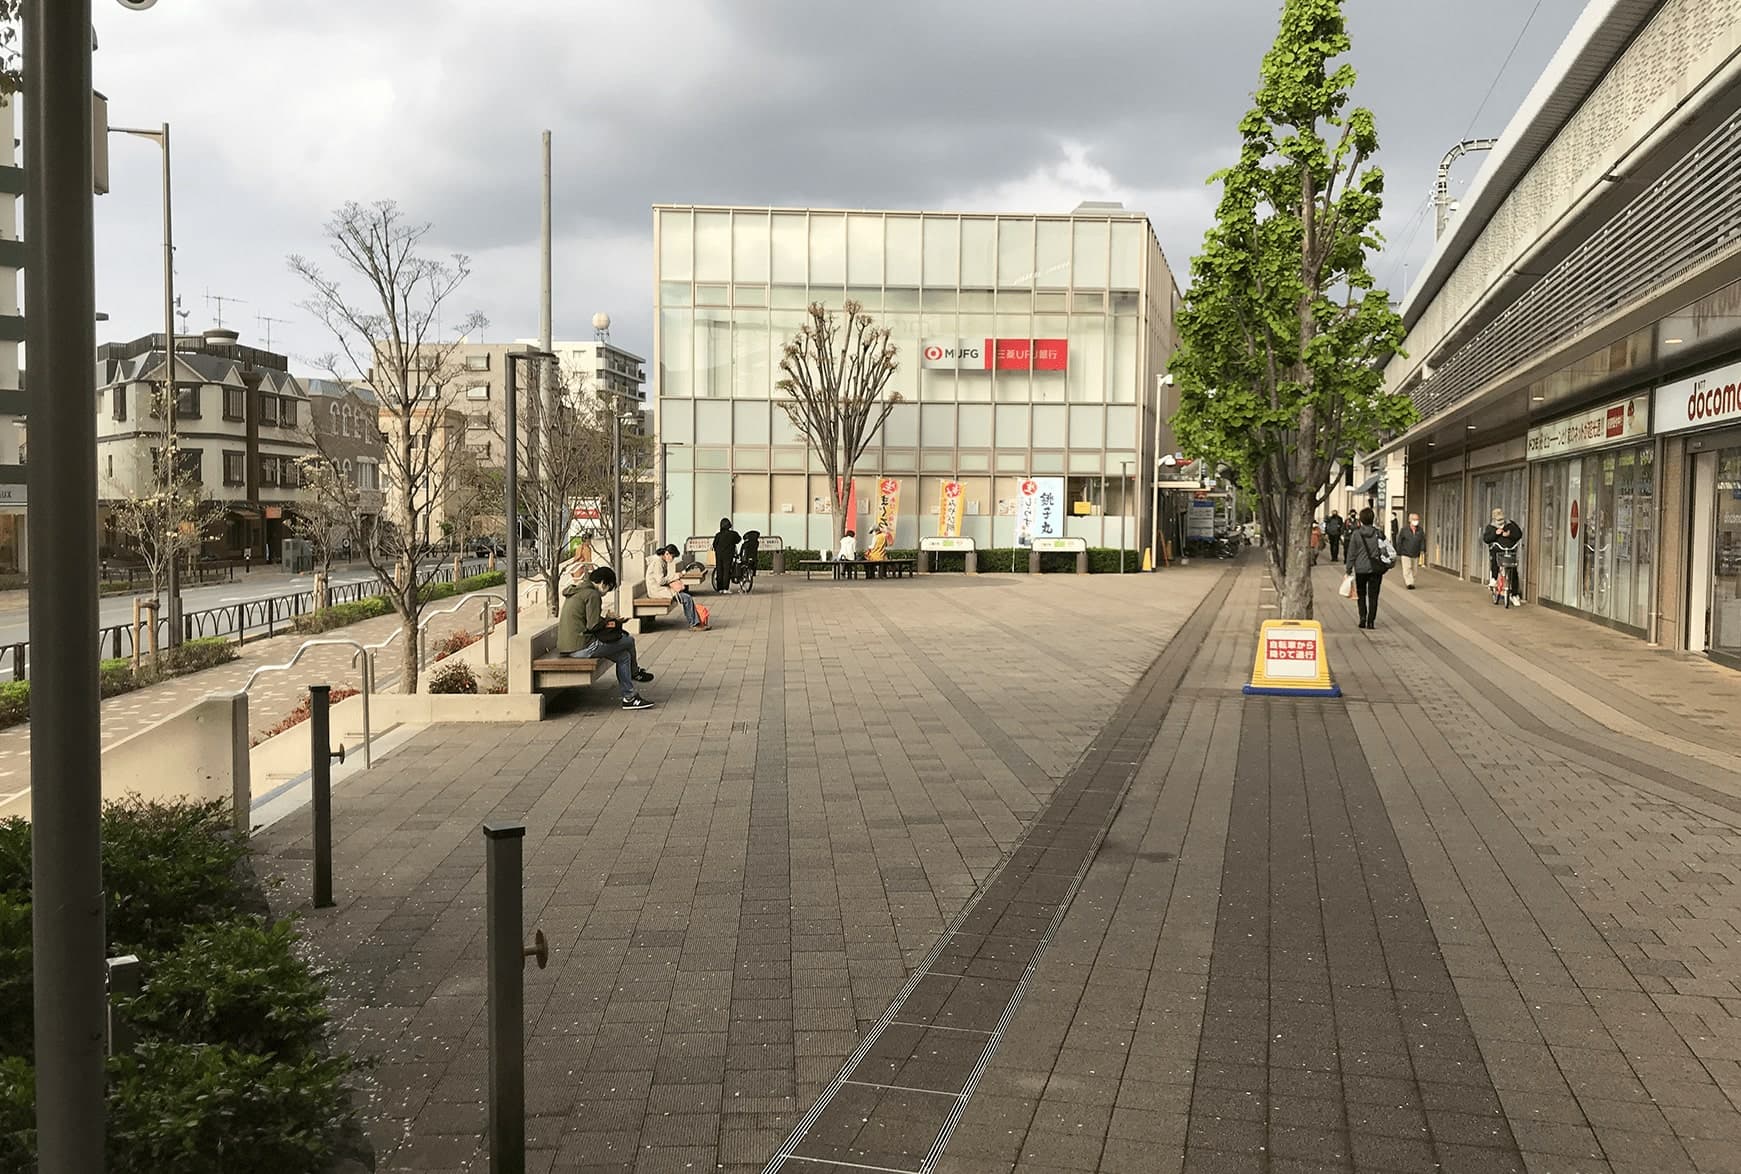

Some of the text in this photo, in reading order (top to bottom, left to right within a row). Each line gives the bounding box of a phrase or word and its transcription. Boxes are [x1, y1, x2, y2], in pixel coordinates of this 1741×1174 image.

[945, 348, 979, 359] MUFG
[997, 348, 1058, 360] 三菱UFJ銀行
[1040, 492, 1054, 534] 銚子丸
